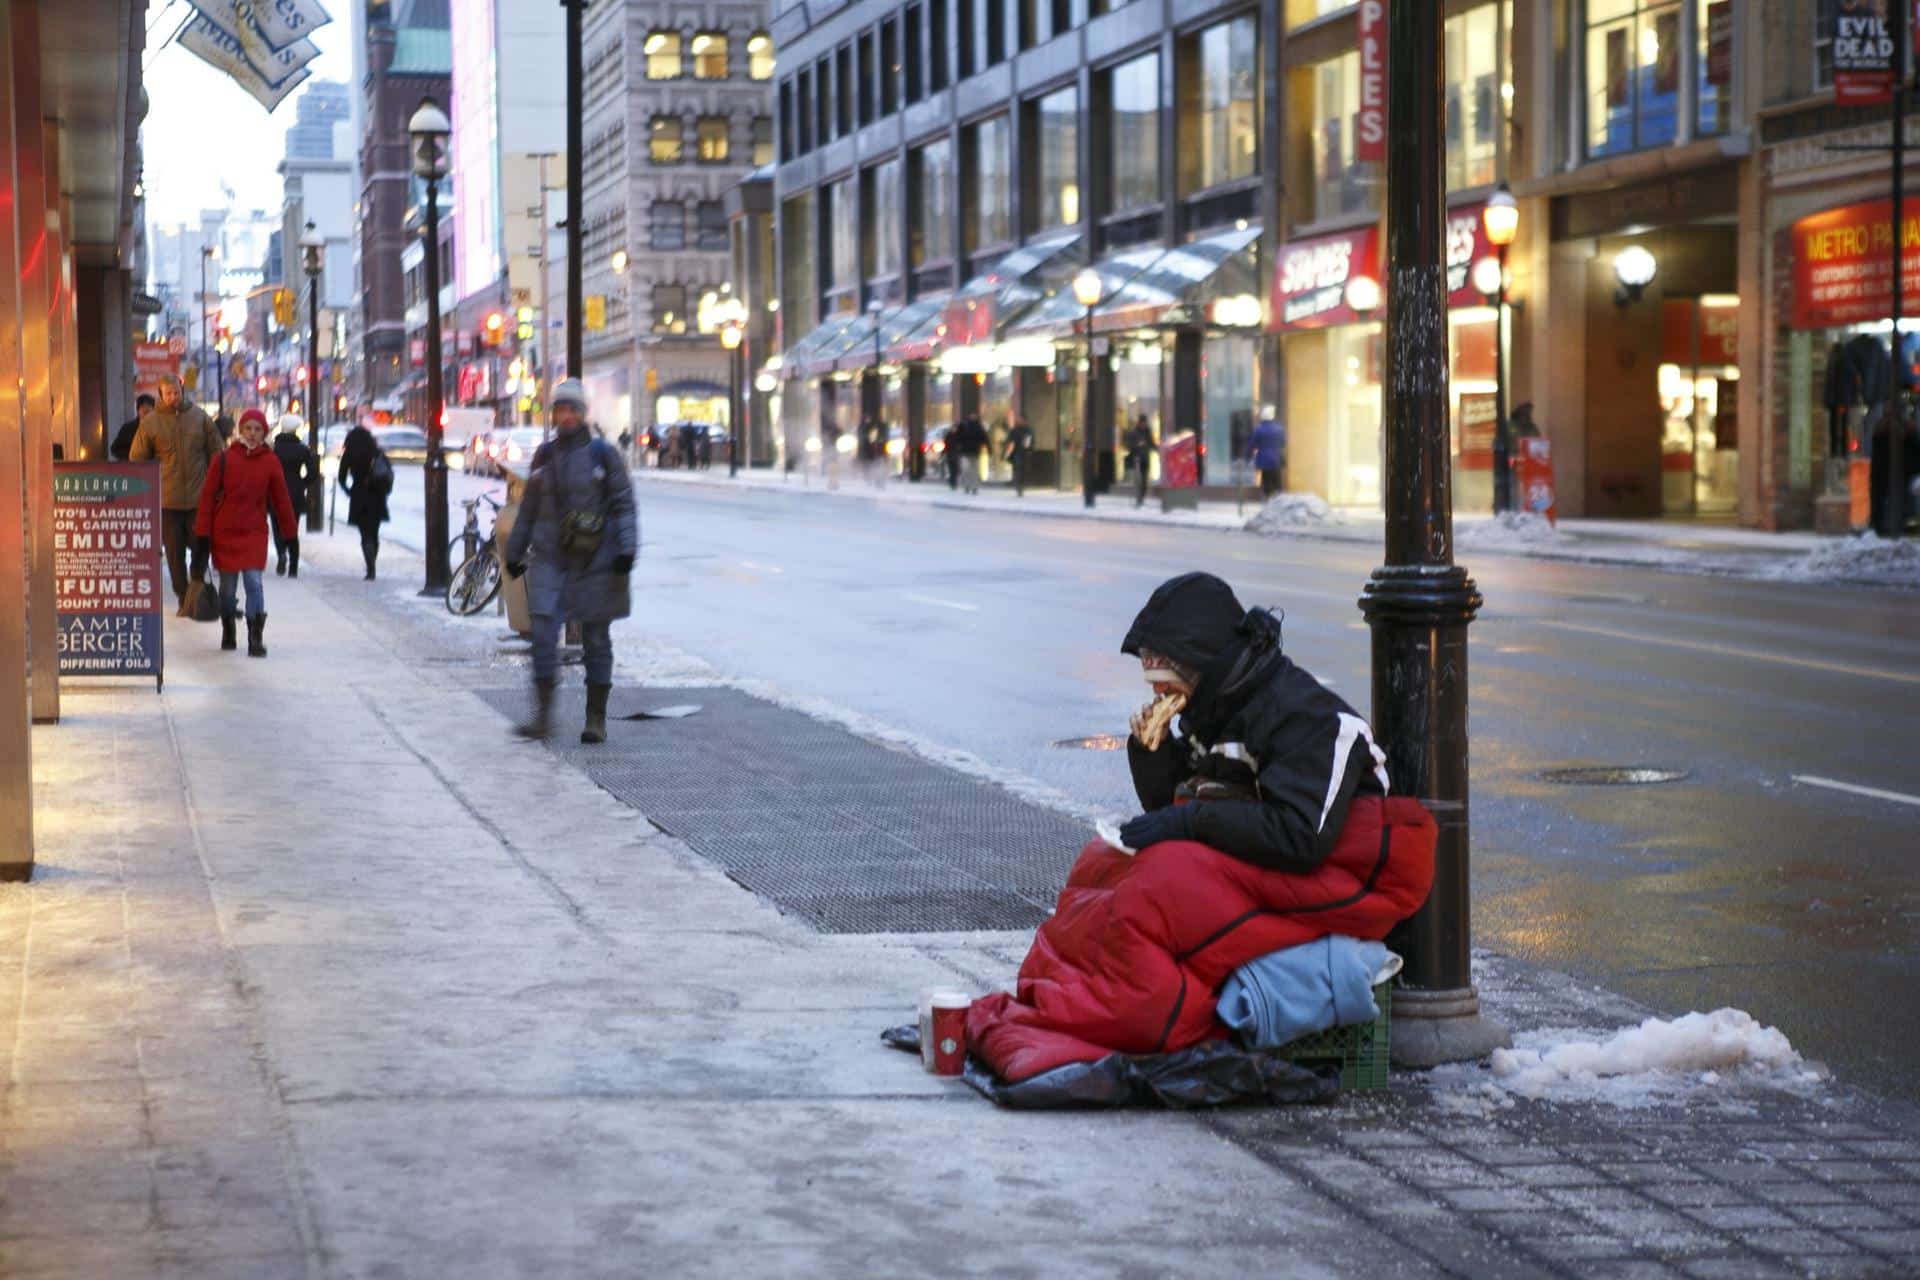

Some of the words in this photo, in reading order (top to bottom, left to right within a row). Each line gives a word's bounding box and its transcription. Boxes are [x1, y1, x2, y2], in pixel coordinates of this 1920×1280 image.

[1838, 16, 1889, 37] EVIL
[1834, 38, 1894, 58] DEAD
[1807, 224, 1869, 261] METRO
[91, 508, 151, 519] LARGEST
[56, 521, 79, 532] OR,
[83, 521, 151, 531] CARRYING
[54, 533, 152, 549] EMIUM
[104, 599, 152, 609] PRICES
[57, 633, 143, 652] BERGER
[60, 659, 122, 669] DIFFERENT
[125, 659, 152, 669] OILS
